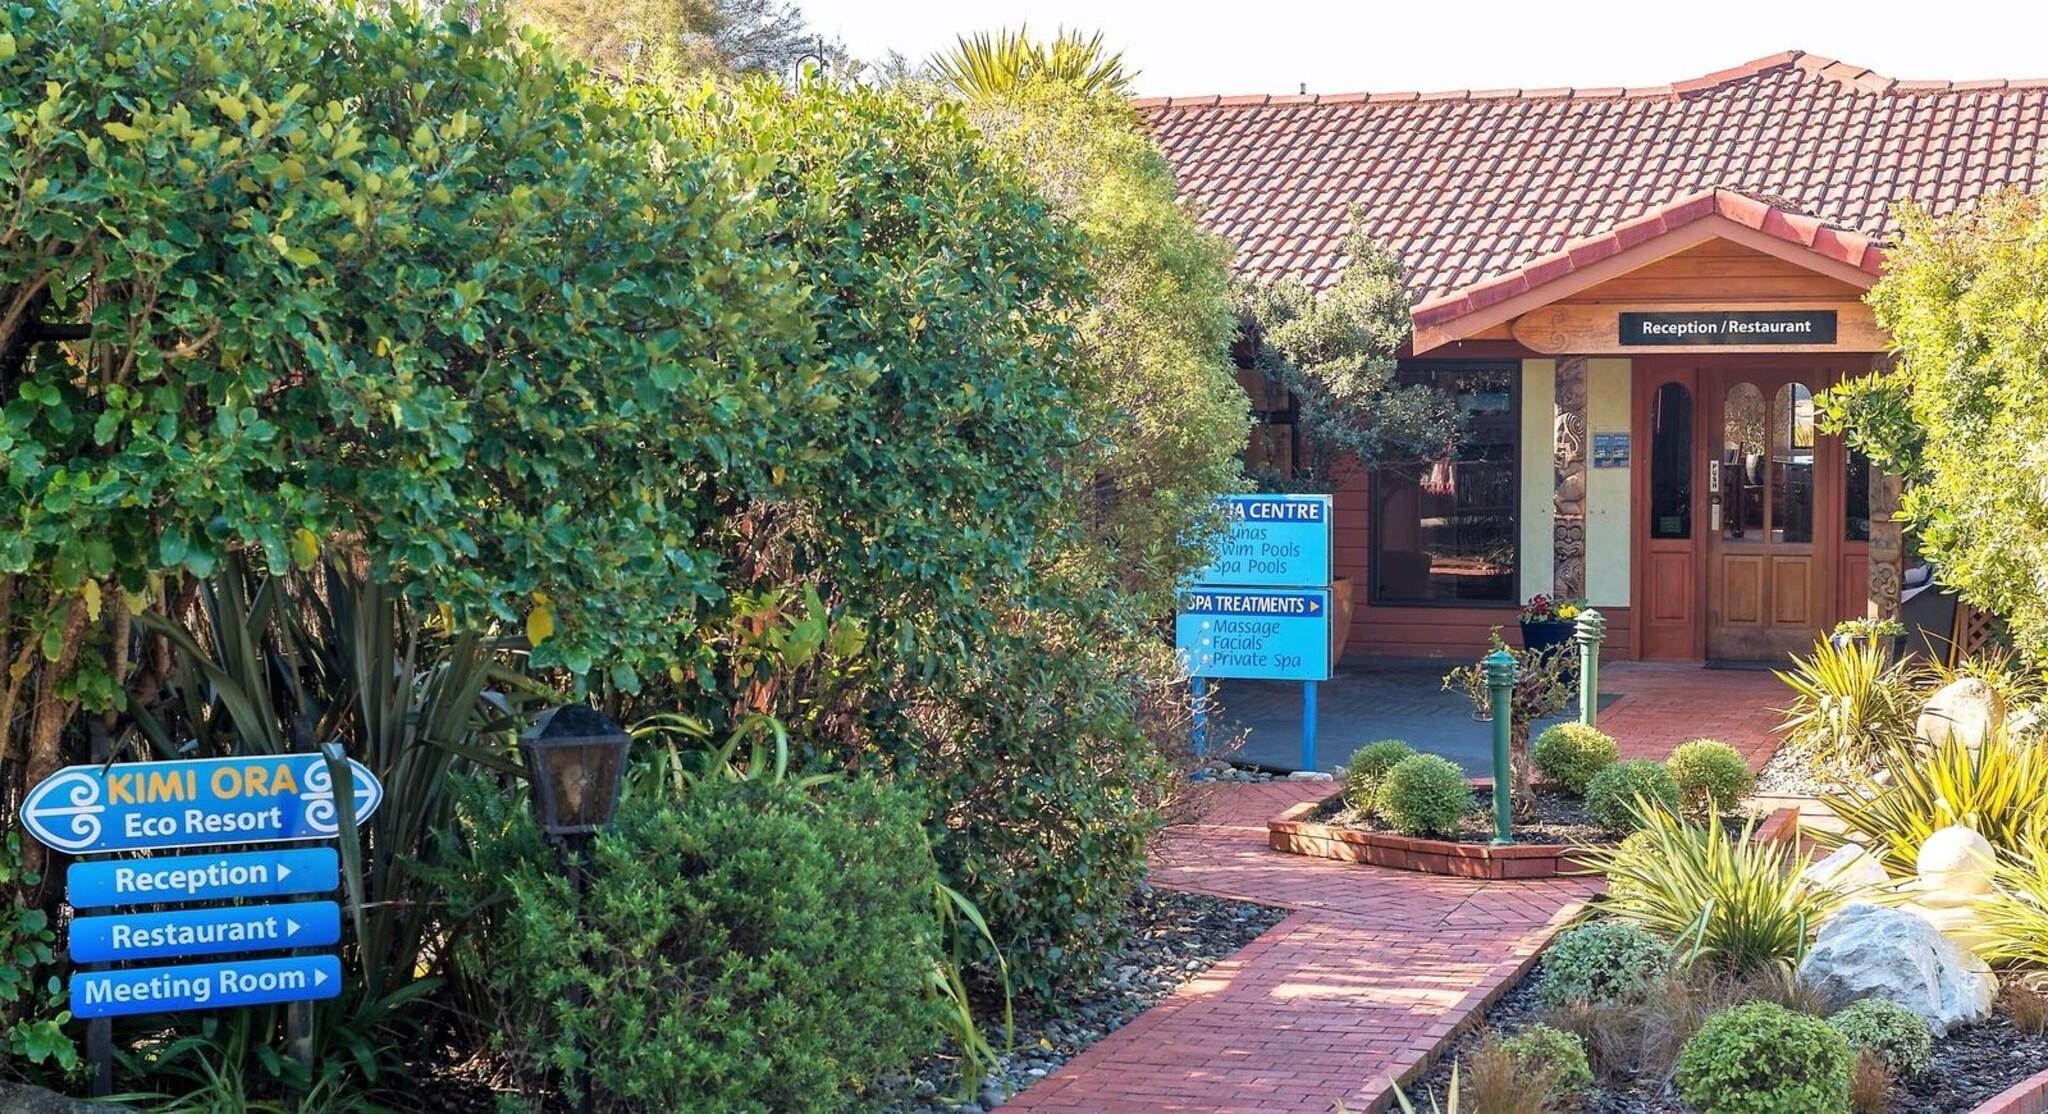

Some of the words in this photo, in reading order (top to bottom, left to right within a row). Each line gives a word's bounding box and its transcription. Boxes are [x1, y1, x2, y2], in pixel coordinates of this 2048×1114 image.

[1643, 321, 1717, 337] Reception
[1250, 503, 1319, 519] CENTRE
[1216, 528, 1268, 541] unas
[1215, 541, 1254, 556] wim
[1262, 542, 1300, 558] Pools
[1213, 560, 1240, 577] Spa
[1248, 559, 1287, 574] Pools
[1187, 594, 1213, 611] SPA
[1215, 596, 1305, 613] TREATMENTS
[1213, 619, 1280, 638] Massage
[1213, 635, 1263, 650] Facials
[1213, 651, 1267, 667] Private
[107, 770, 197, 805] KIMI
[210, 763, 298, 799] ORA
[124, 812, 177, 838] Eco
[184, 807, 282, 834] Resort
[115, 861, 268, 894] Reception
[111, 916, 278, 949] Restaurant
[84, 974, 210, 1004] Meeting
[218, 969, 306, 994] Room
